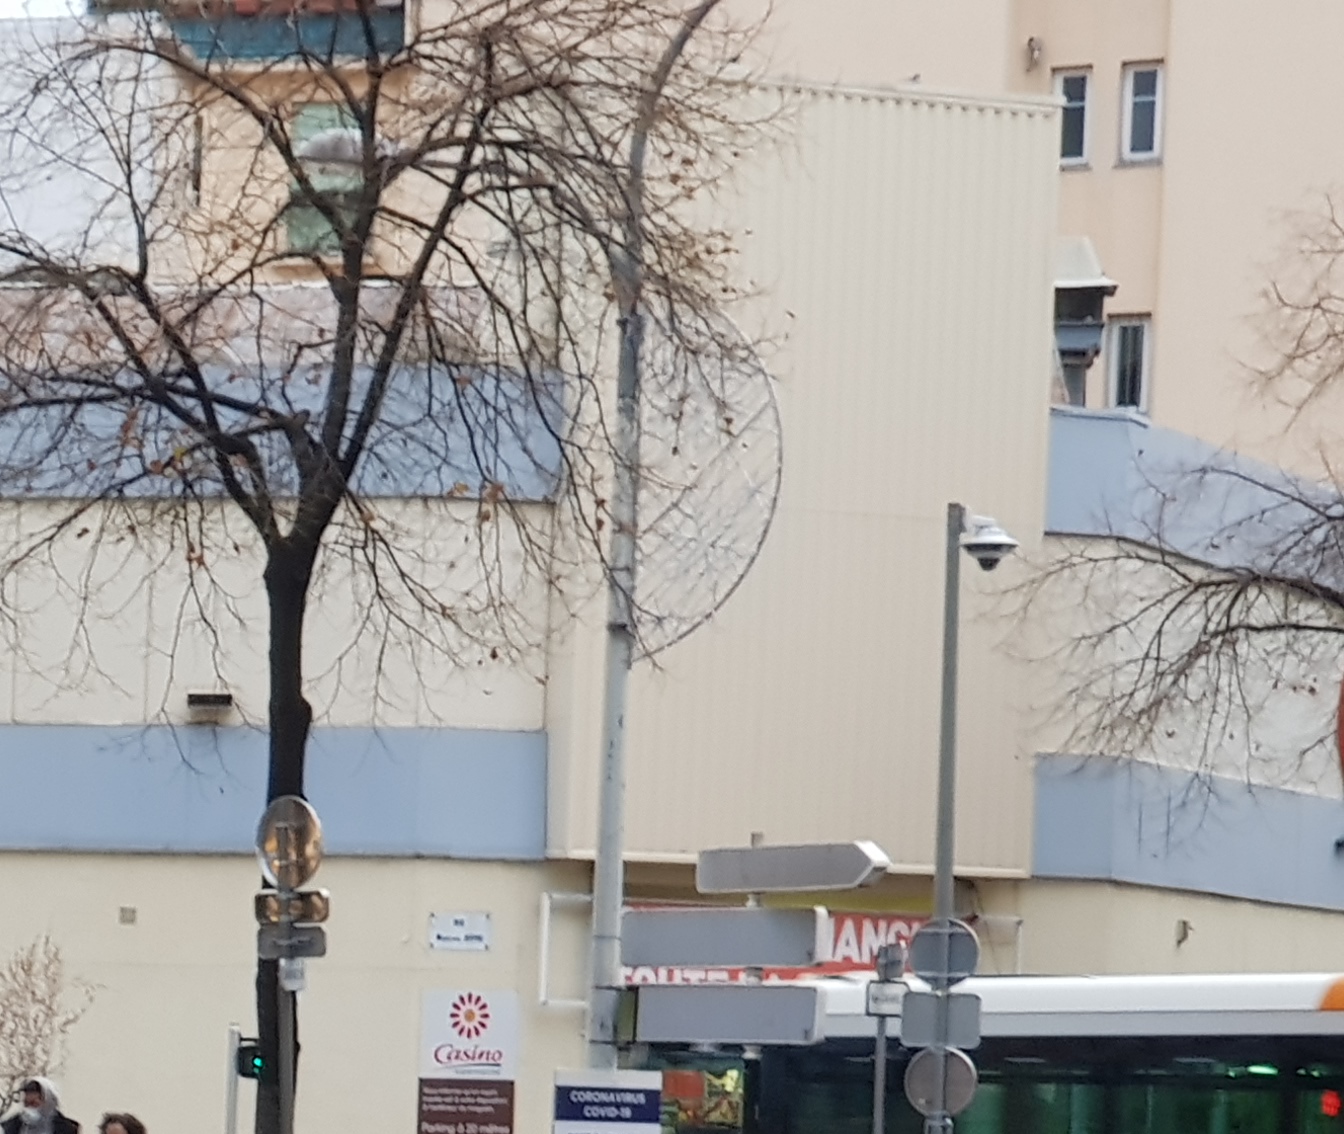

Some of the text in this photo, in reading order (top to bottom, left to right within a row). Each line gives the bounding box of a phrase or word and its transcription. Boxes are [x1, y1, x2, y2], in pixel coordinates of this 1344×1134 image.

[433, 1043, 503, 1066] Casino
[569, 1090, 646, 1104] CORONAVIRUS
[583, 1105, 632, 1118] COVID-19
